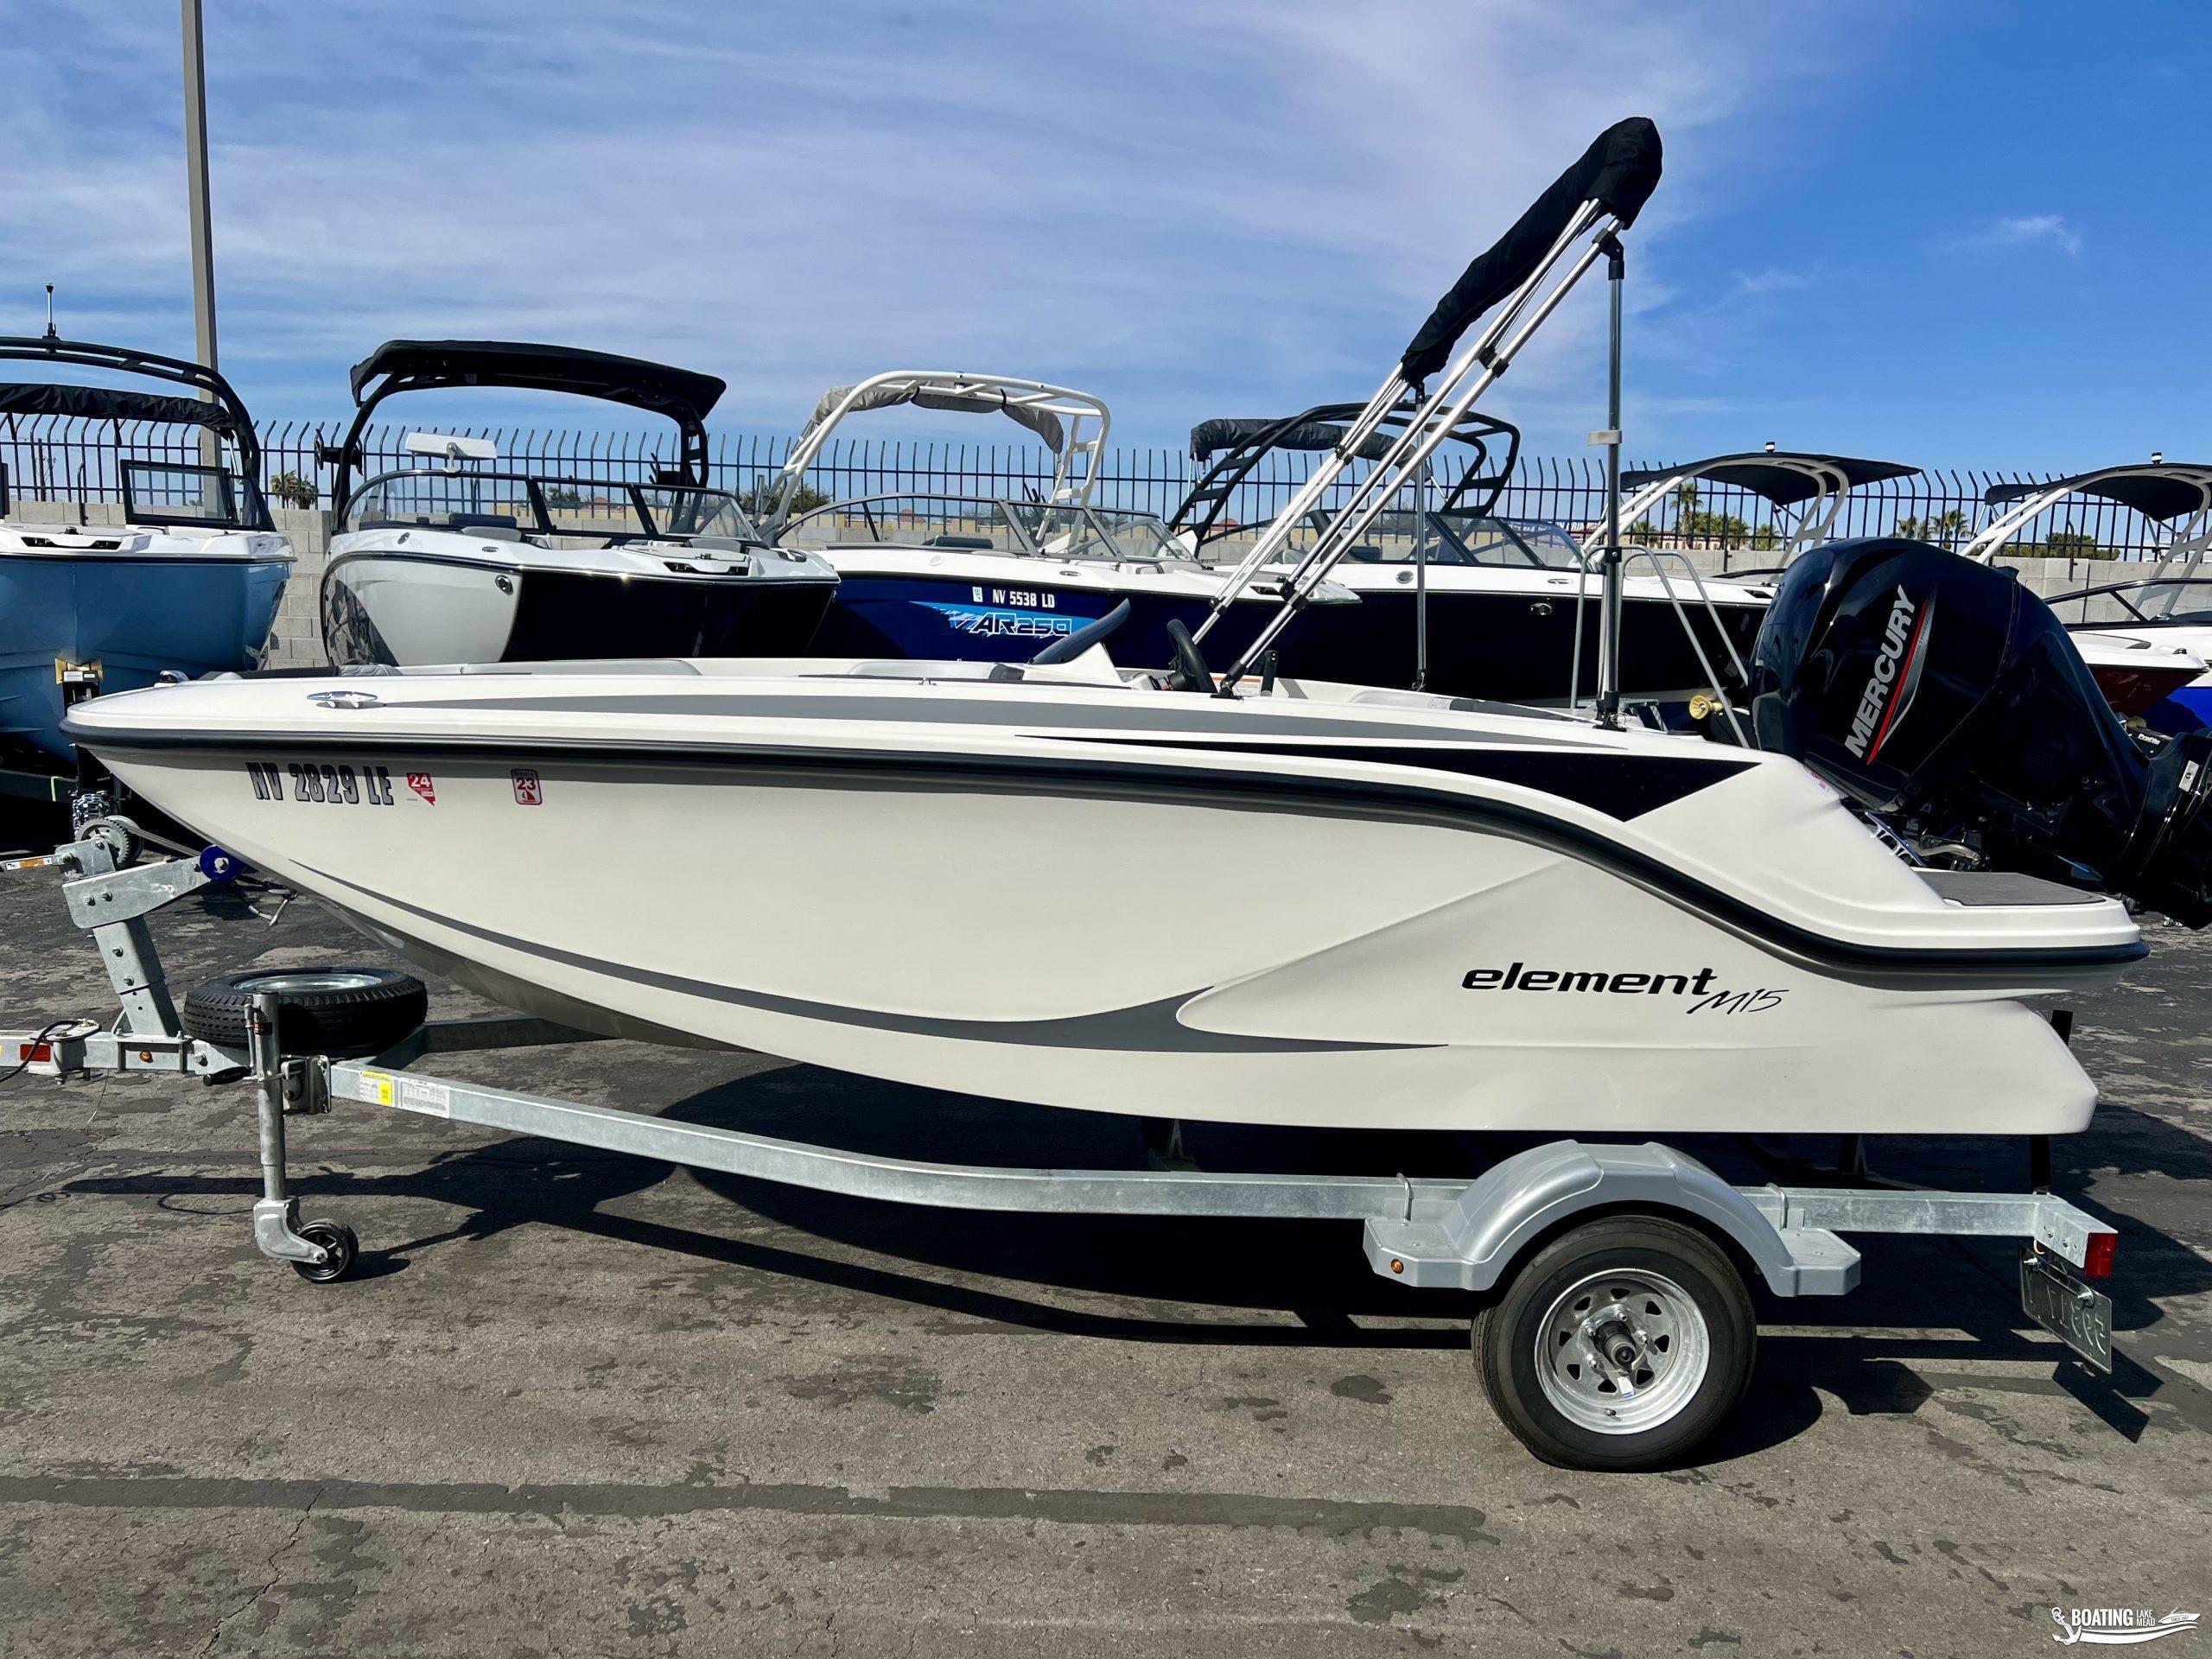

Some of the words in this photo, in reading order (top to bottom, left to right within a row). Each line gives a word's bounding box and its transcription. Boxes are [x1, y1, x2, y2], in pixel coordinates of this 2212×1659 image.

[993, 588, 1006, 604] NV
[1009, 590, 1037, 607] 5538
[1041, 593, 1055, 608] LD
[1844, 583, 1916, 759] MERCURY
[245, 762, 283, 800] NV
[288, 763, 359, 804] 2829
[363, 766, 394, 805] LE
[410, 773, 431, 788] 24
[516, 777, 537, 791] 23
[1461, 962, 1719, 995] element
[1686, 988, 1789, 1014] M15
